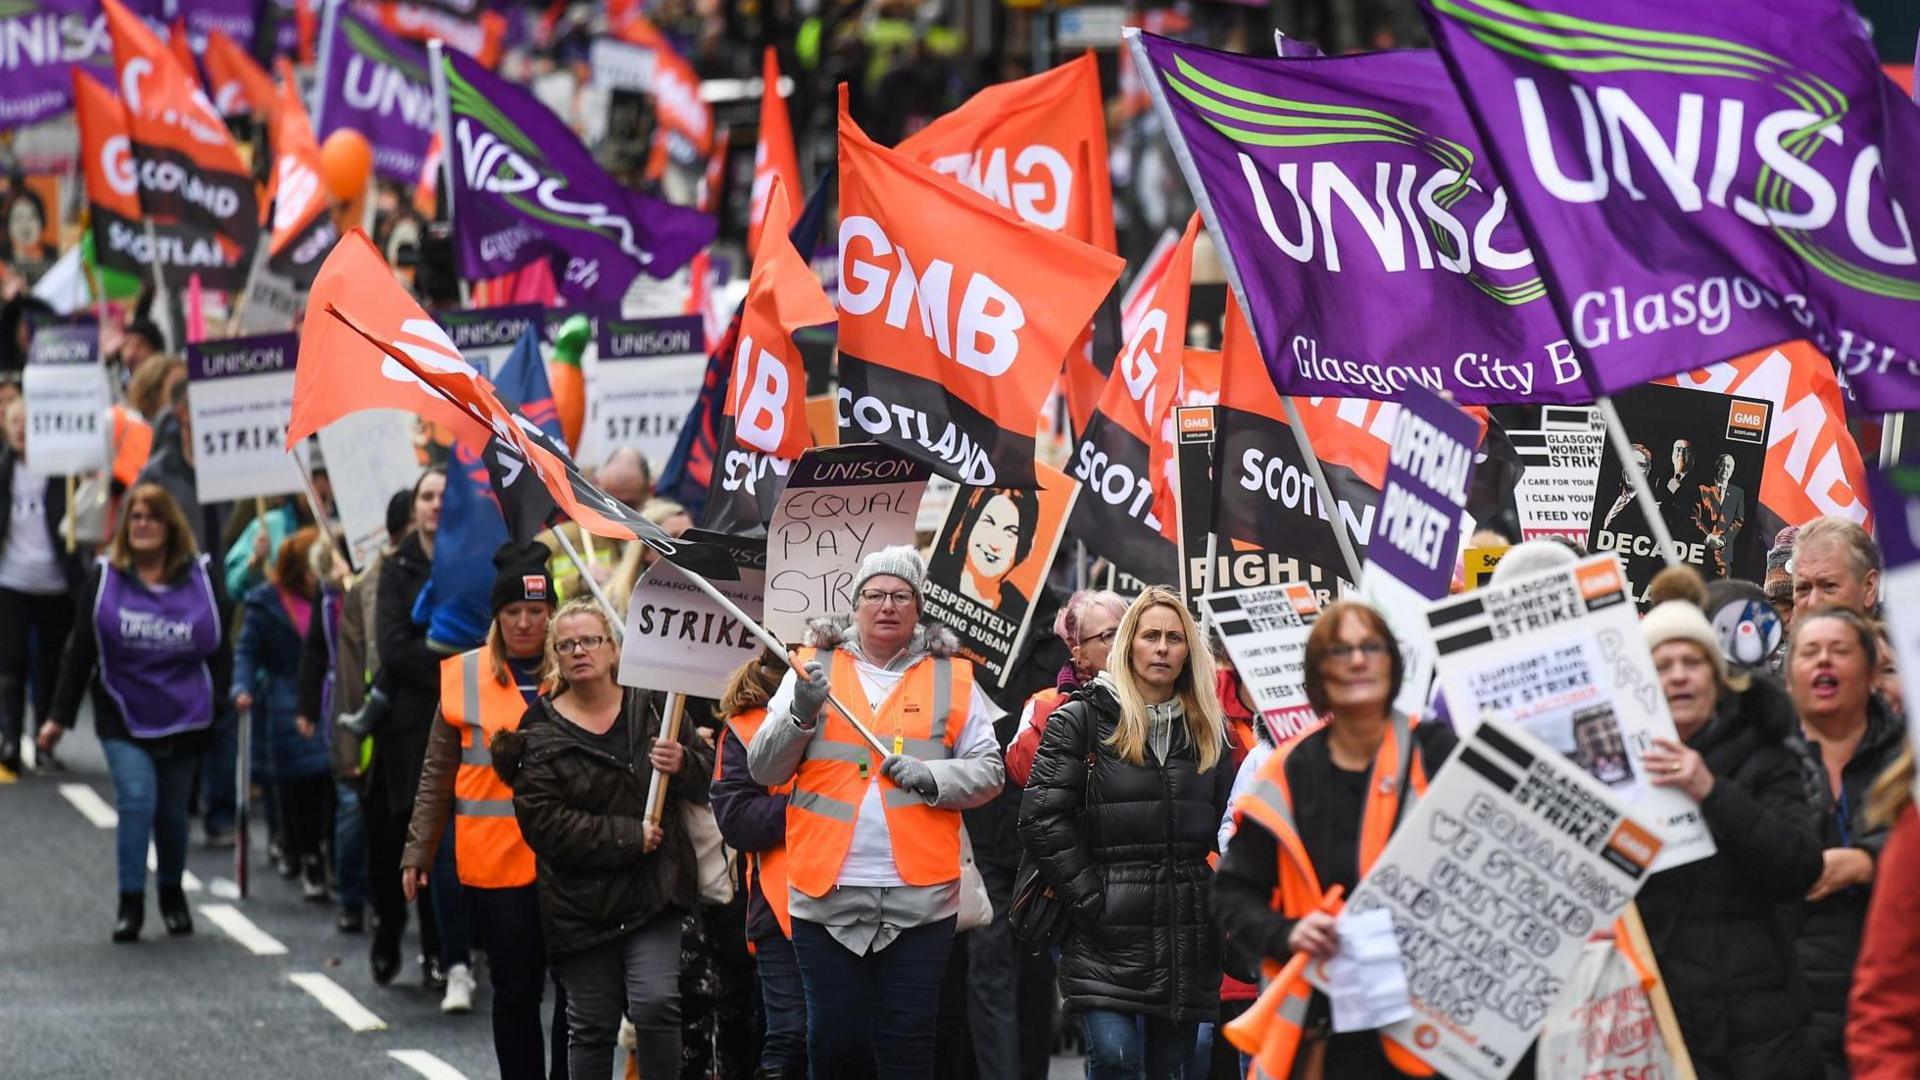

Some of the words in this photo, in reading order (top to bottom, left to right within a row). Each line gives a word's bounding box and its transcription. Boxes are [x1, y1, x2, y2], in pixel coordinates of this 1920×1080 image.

[839, 215, 1026, 377] GMB
[1572, 276, 1779, 349] Glasgo
[611, 331, 691, 356] UNISON
[202, 346, 284, 377] UNISON
[1292, 335, 1443, 394] Glasgow
[1453, 353, 1534, 395] City
[608, 413, 684, 441] STRIK
[1184, 417, 1209, 429] GMB
[1735, 412, 1761, 426] GMB
[203, 423, 290, 456] STRIK
[839, 387, 996, 486] COTLAND
[1548, 434, 1602, 445] GLASGOW
[813, 459, 915, 481] UNISON
[1389, 407, 1471, 507] OFFICIAL
[1551, 456, 1601, 468] STRIK
[785, 489, 912, 520] EQUAL
[1532, 494, 1565, 502] CLEAN
[1568, 494, 1594, 502] YOUR
[1378, 481, 1450, 571] PICKET
[1537, 511, 1568, 521] FEED
[778, 520, 874, 564] PAY
[771, 568, 853, 613] STR
[1239, 589, 1285, 603] GLASGOW
[1487, 572, 1570, 604] GLASGOW
[1492, 587, 1576, 618] WOMEN'S
[922, 579, 1018, 638] DESPERATELY
[1252, 613, 1302, 633] STRIKE
[1497, 602, 1582, 640] STRIKE
[639, 604, 763, 650] STRIKE
[923, 600, 968, 633] EEKING
[968, 623, 1012, 655] SUSAN
[1255, 666, 1281, 677] CLEAN
[1521, 671, 1591, 700] STRIKE
[1266, 684, 1294, 699] FEED
[1536, 761, 1620, 820] GLASGOW
[1515, 787, 1602, 851] STRIKE
[1463, 790, 1572, 880] EQUAL
[1568, 860, 1629, 915] PAY
[1429, 808, 1483, 861] WE
[1480, 848, 1595, 938] STAND
[1429, 855, 1561, 959] UNITED
